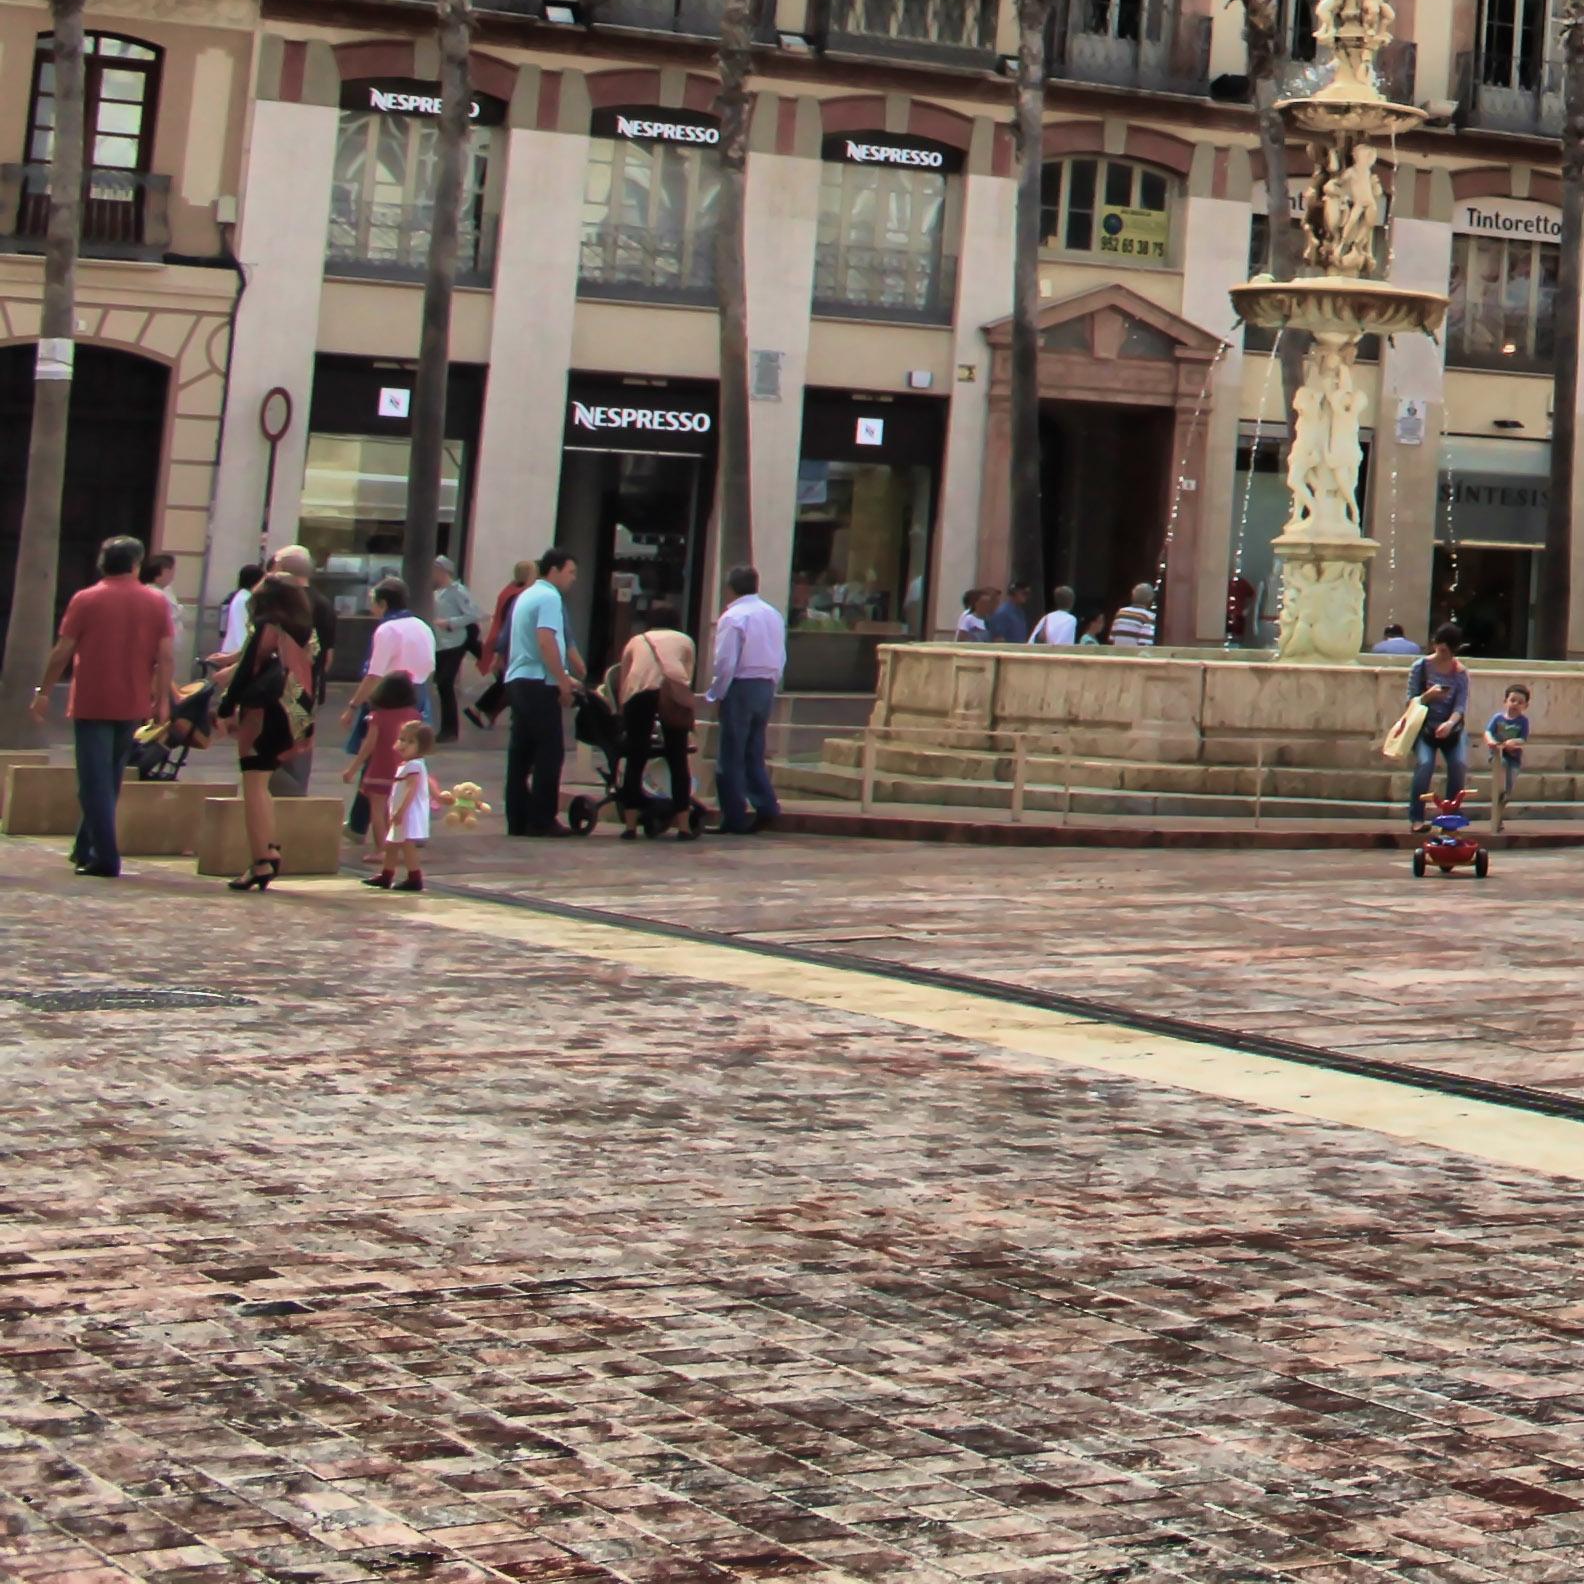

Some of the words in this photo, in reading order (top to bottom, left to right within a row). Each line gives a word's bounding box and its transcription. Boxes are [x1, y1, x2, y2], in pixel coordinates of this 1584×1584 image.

[369, 87, 481, 118] NESPREO
[616, 115, 720, 144] NESPRESSO
[845, 139, 943, 167] NESPRESSO
[1466, 207, 1561, 236] Tintoretto
[571, 400, 711, 433] NESPRESSO
